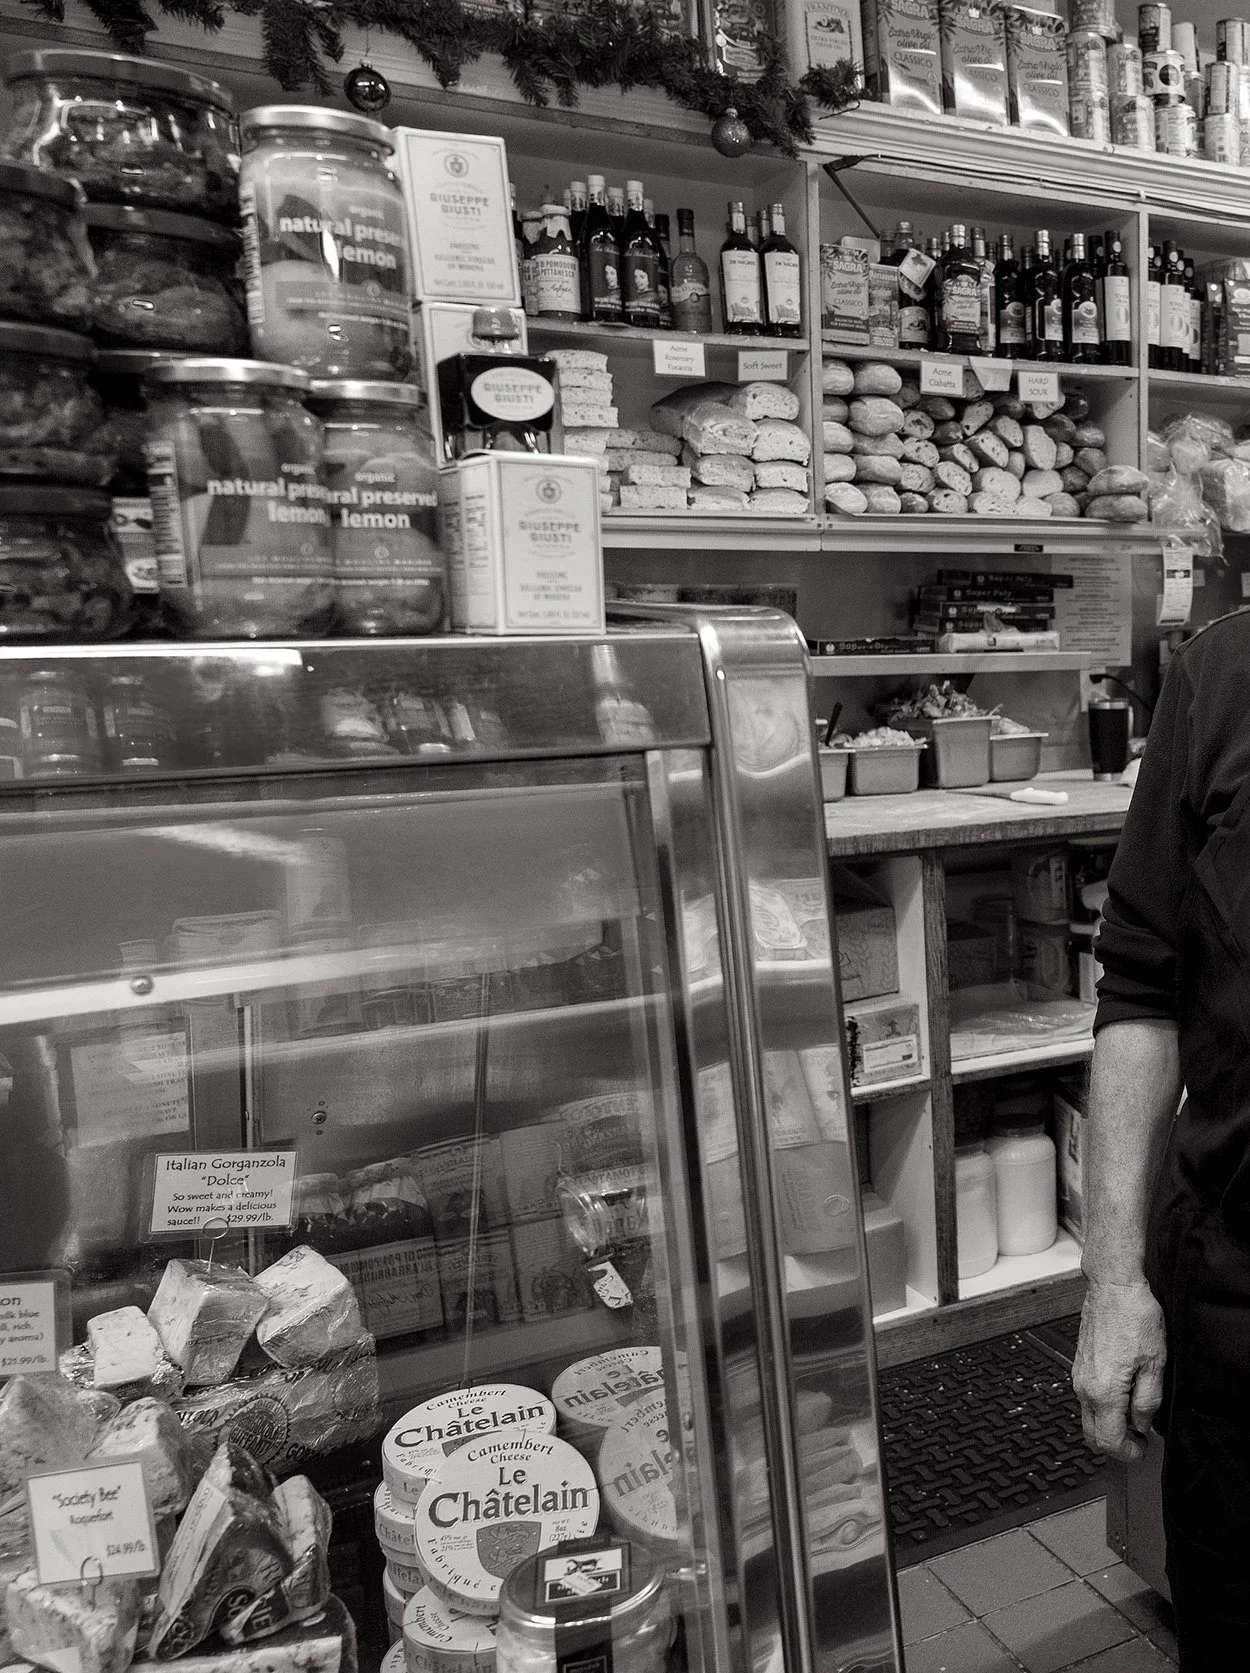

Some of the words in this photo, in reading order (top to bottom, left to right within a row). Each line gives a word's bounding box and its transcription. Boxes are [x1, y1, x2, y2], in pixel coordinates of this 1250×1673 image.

[894, 52, 933, 68] CLASSICO
[1023, 83, 1059, 97] CLASSICO
[429, 191, 489, 207] GIUSEPPE
[441, 204, 482, 217] GIUSTI
[280, 216, 351, 237] natural
[355, 223, 402, 247] prese
[338, 241, 397, 270] lemon
[832, 261, 864, 273] SAGRA
[952, 286, 977, 296] SAGRA
[743, 361, 758, 370] Soft
[759, 361, 783, 370] Sweet
[483, 383, 543, 394] GIUSEPPE
[1029, 388, 1048, 396] SOUR
[494, 393, 535, 404] GIUSTI
[206, 478, 286, 497] natural
[342, 508, 412, 529] lemon
[518, 520, 581, 534] GIUSEPPE
[529, 532, 572, 544] GIUSTI
[166, 1158, 207, 1171] Italian
[211, 1155, 286, 1171] Gorganzola
[173, 1193, 185, 1201] So
[187, 1190, 213, 1200] sweet
[216, 1190, 233, 1199] and
[236, 1189, 273, 1200] creamy!
[196, 1203, 225, 1212] makes
[235, 1202, 277, 1211] delicious
[167, 1217, 200, 1226] sauce!!
[226, 1213, 274, 1224] $29.99/lb.
[19, 1310, 40, 1318] blue
[426, 1389, 506, 1411] Camembert
[448, 1398, 486, 1409] Cheese
[457, 1405, 483, 1418] Le
[393, 1404, 546, 1448] Châtelain
[468, 1437, 554, 1462] Camembert
[490, 1452, 532, 1464] Cheese
[498, 1466, 526, 1486] Le
[428, 1479, 591, 1529] Châtelain
[379, 1523, 414, 1546] Châtel
